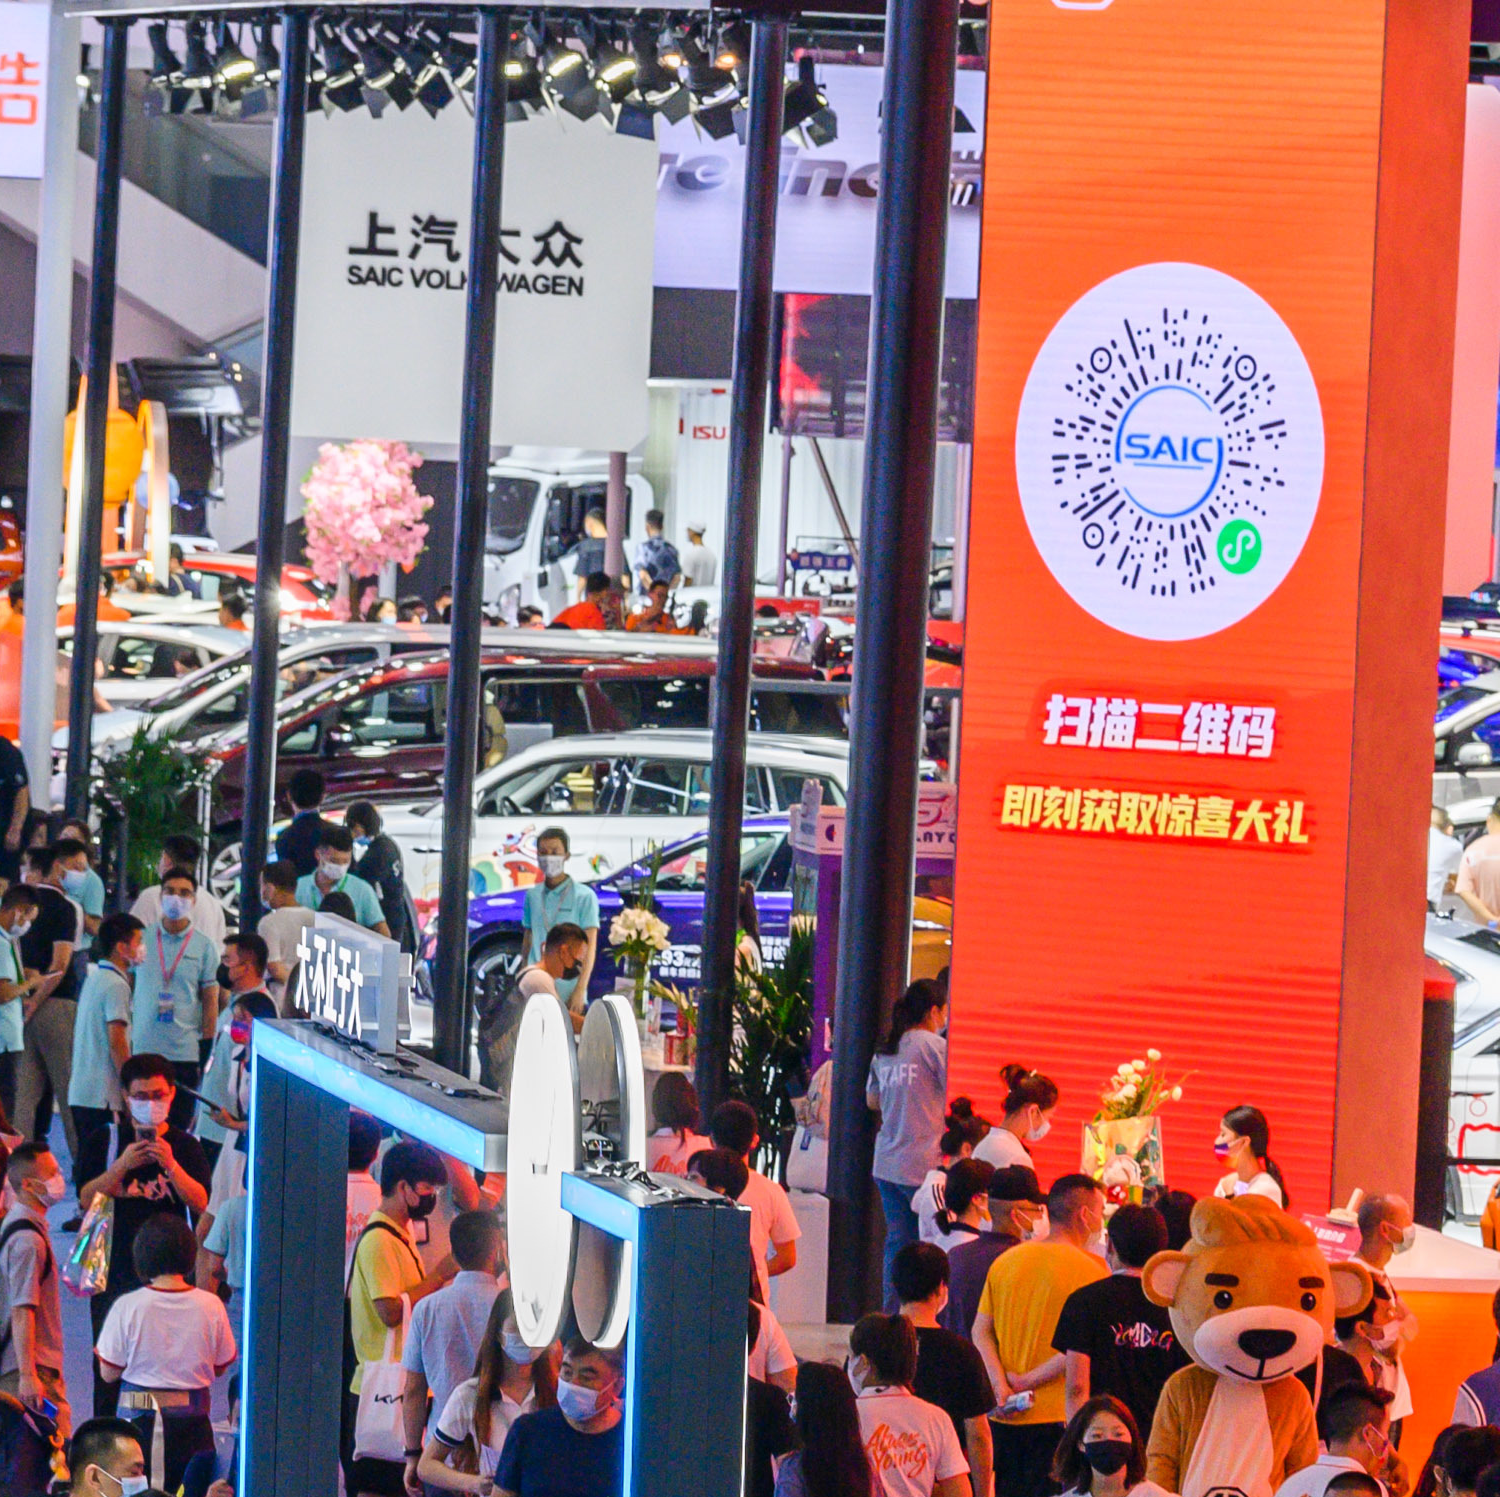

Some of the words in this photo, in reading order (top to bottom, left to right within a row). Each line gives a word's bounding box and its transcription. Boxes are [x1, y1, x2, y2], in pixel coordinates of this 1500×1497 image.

[348, 264, 403, 288] SAIC
[411, 268, 584, 297] VOLWAGEN
[1125, 434, 1213, 465] SAIC
[1043, 694, 1276, 758] 扫描二维码
[1001, 784, 1309, 844] 即刻获取惊喜大礼
